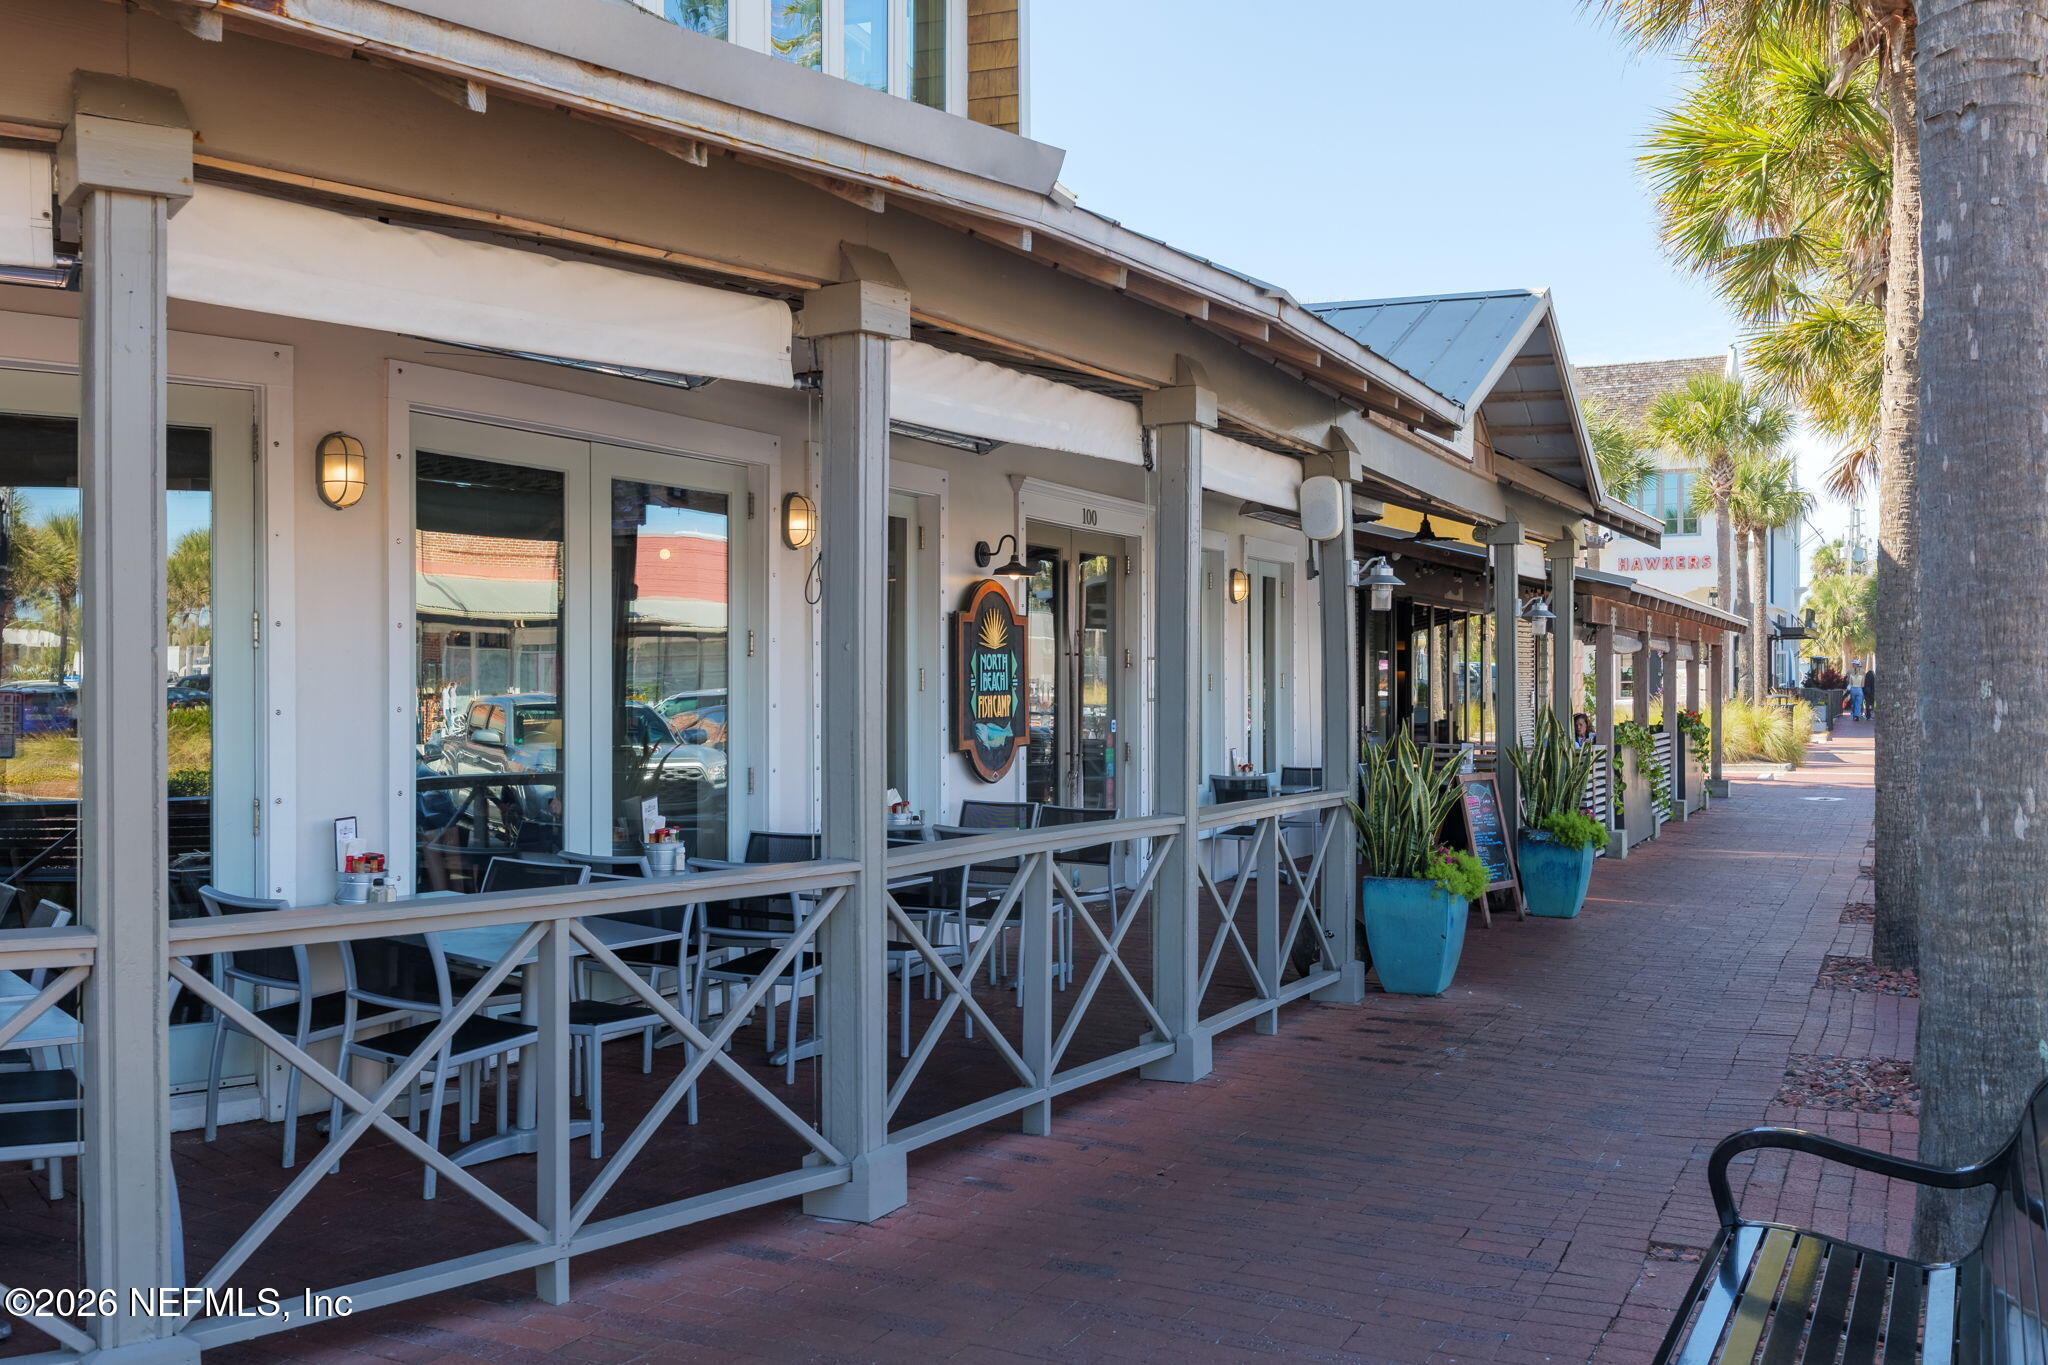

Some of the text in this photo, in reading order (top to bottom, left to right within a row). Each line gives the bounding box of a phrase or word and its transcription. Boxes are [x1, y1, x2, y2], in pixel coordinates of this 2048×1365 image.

[1082, 508, 1098, 526] 100
[1617, 555, 1712, 571] HAWKERS
[980, 653, 1008, 671] NORTH
[982, 671, 1008, 691] BEACH
